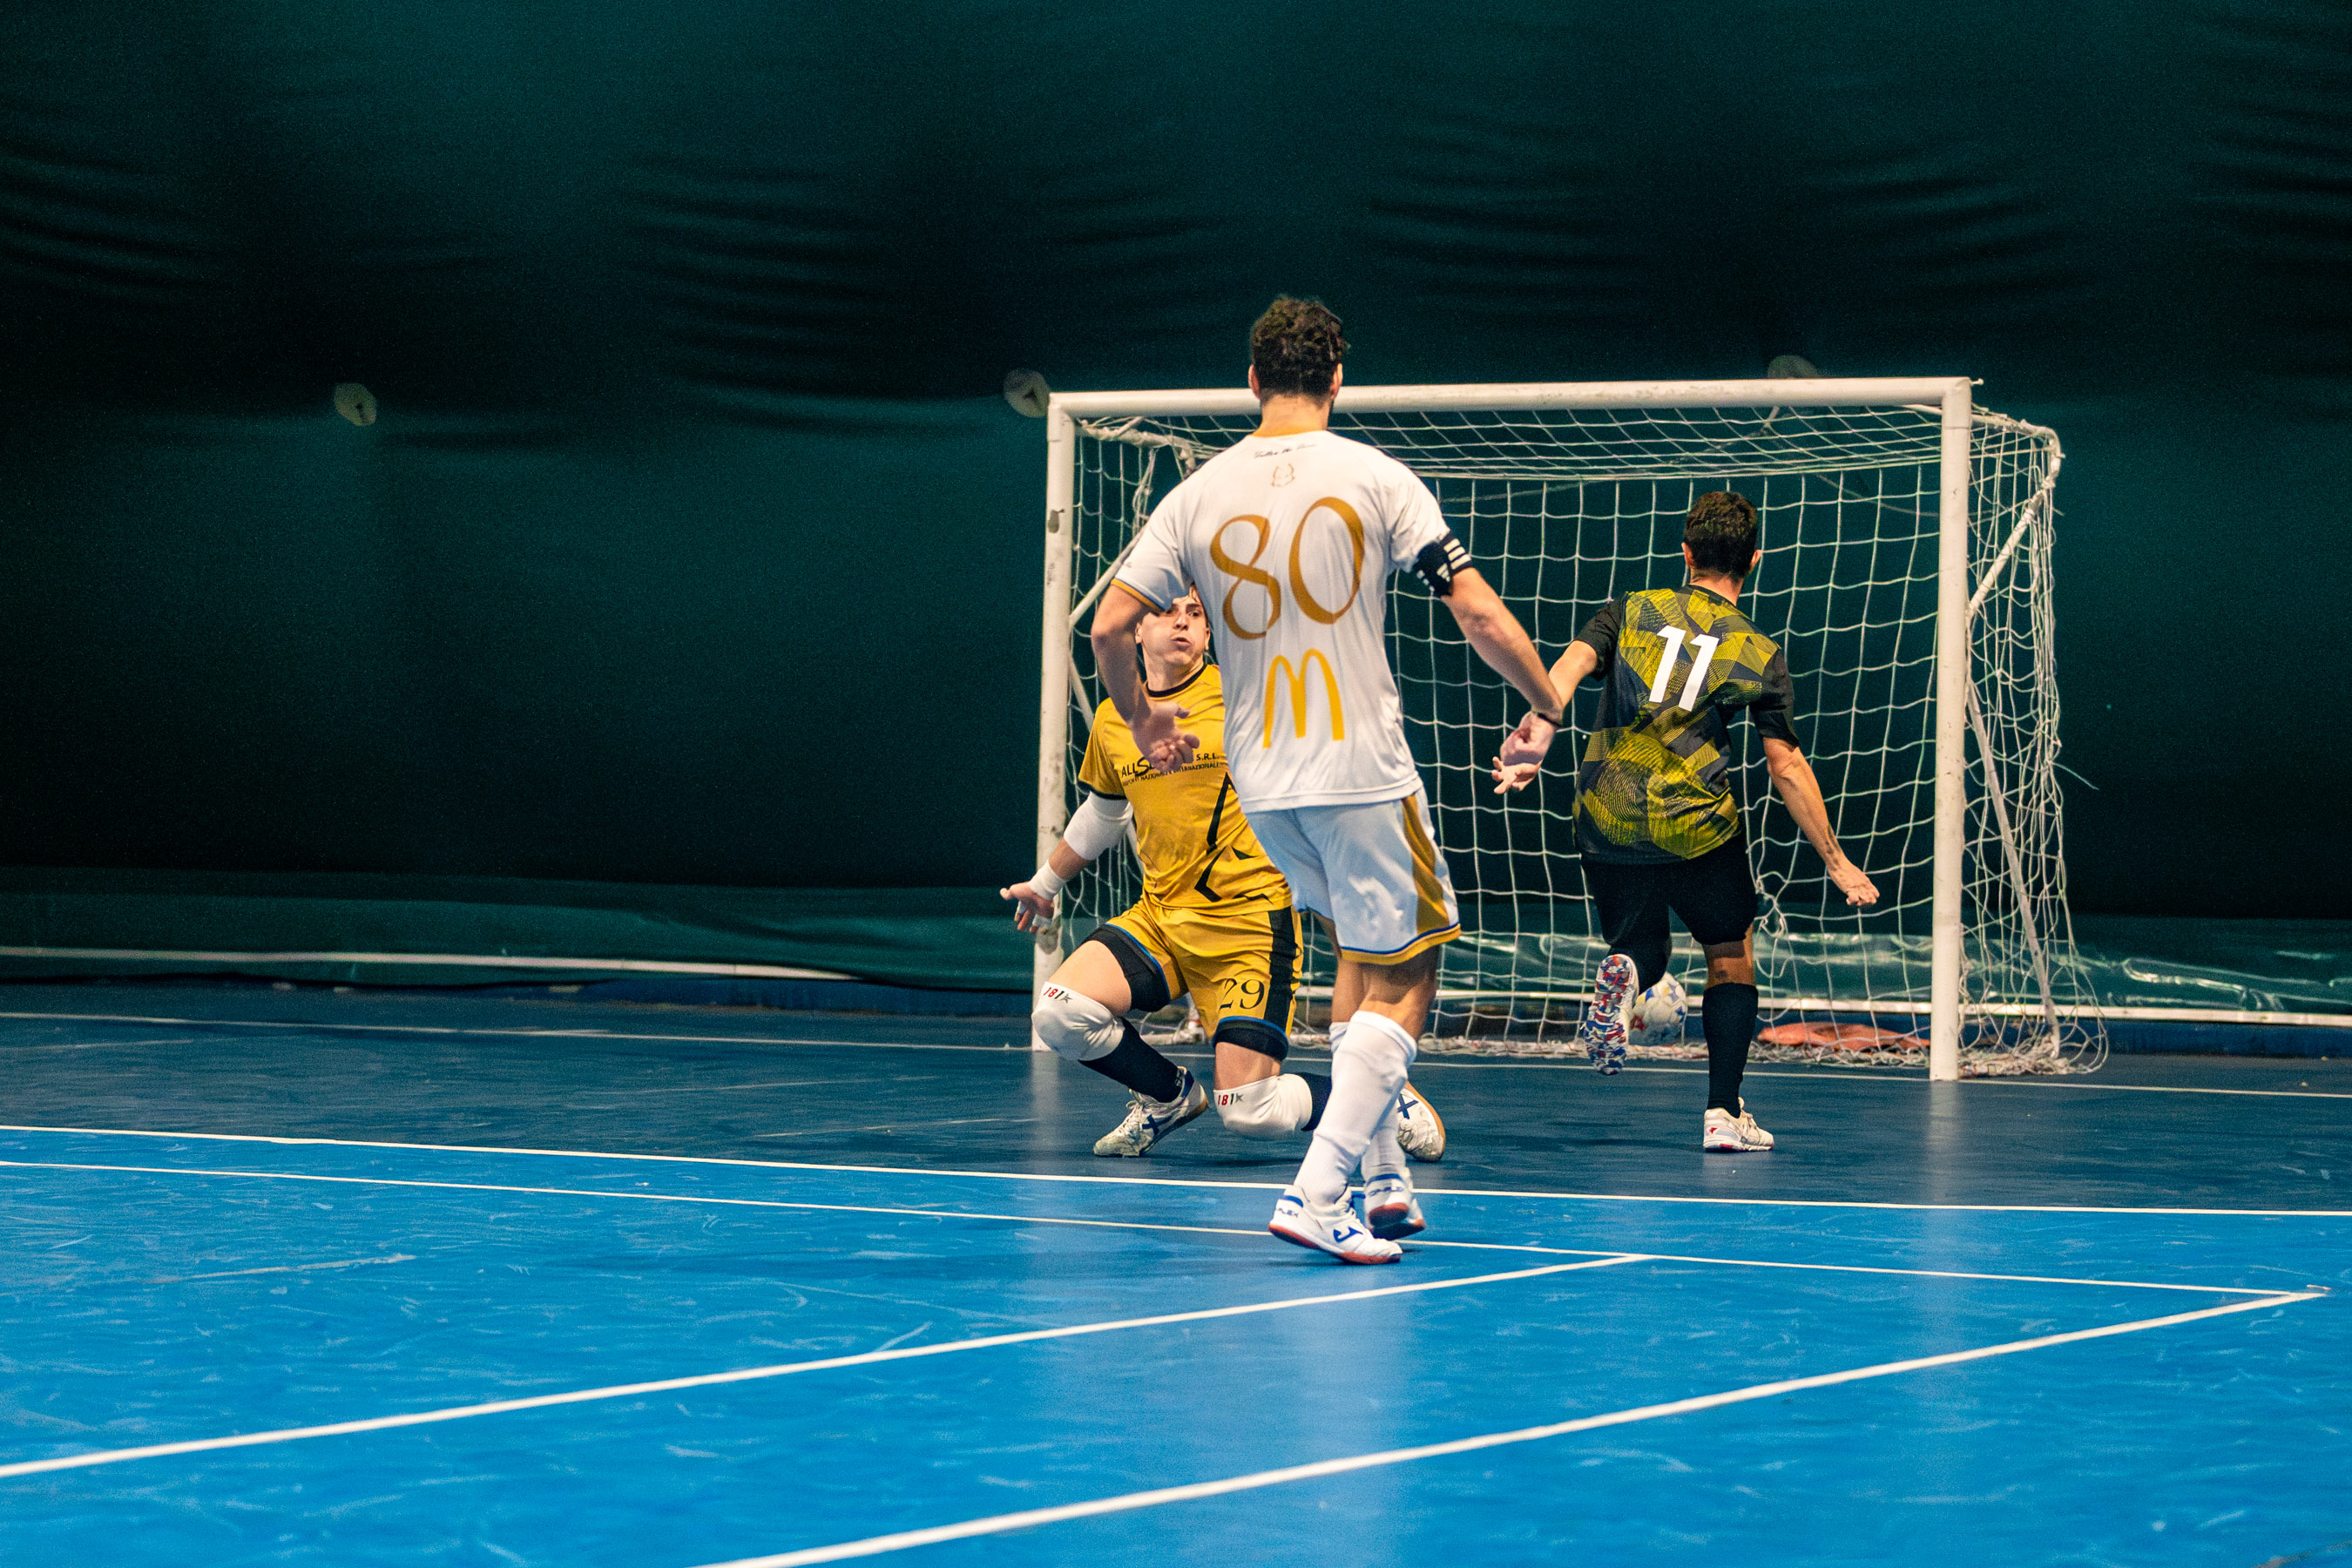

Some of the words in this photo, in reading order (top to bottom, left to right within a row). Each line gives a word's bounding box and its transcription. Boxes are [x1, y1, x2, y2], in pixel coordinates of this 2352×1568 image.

[1210, 497, 1365, 640] 80
[1648, 625, 1720, 712] 11
[1220, 977, 1265, 1010] 29
